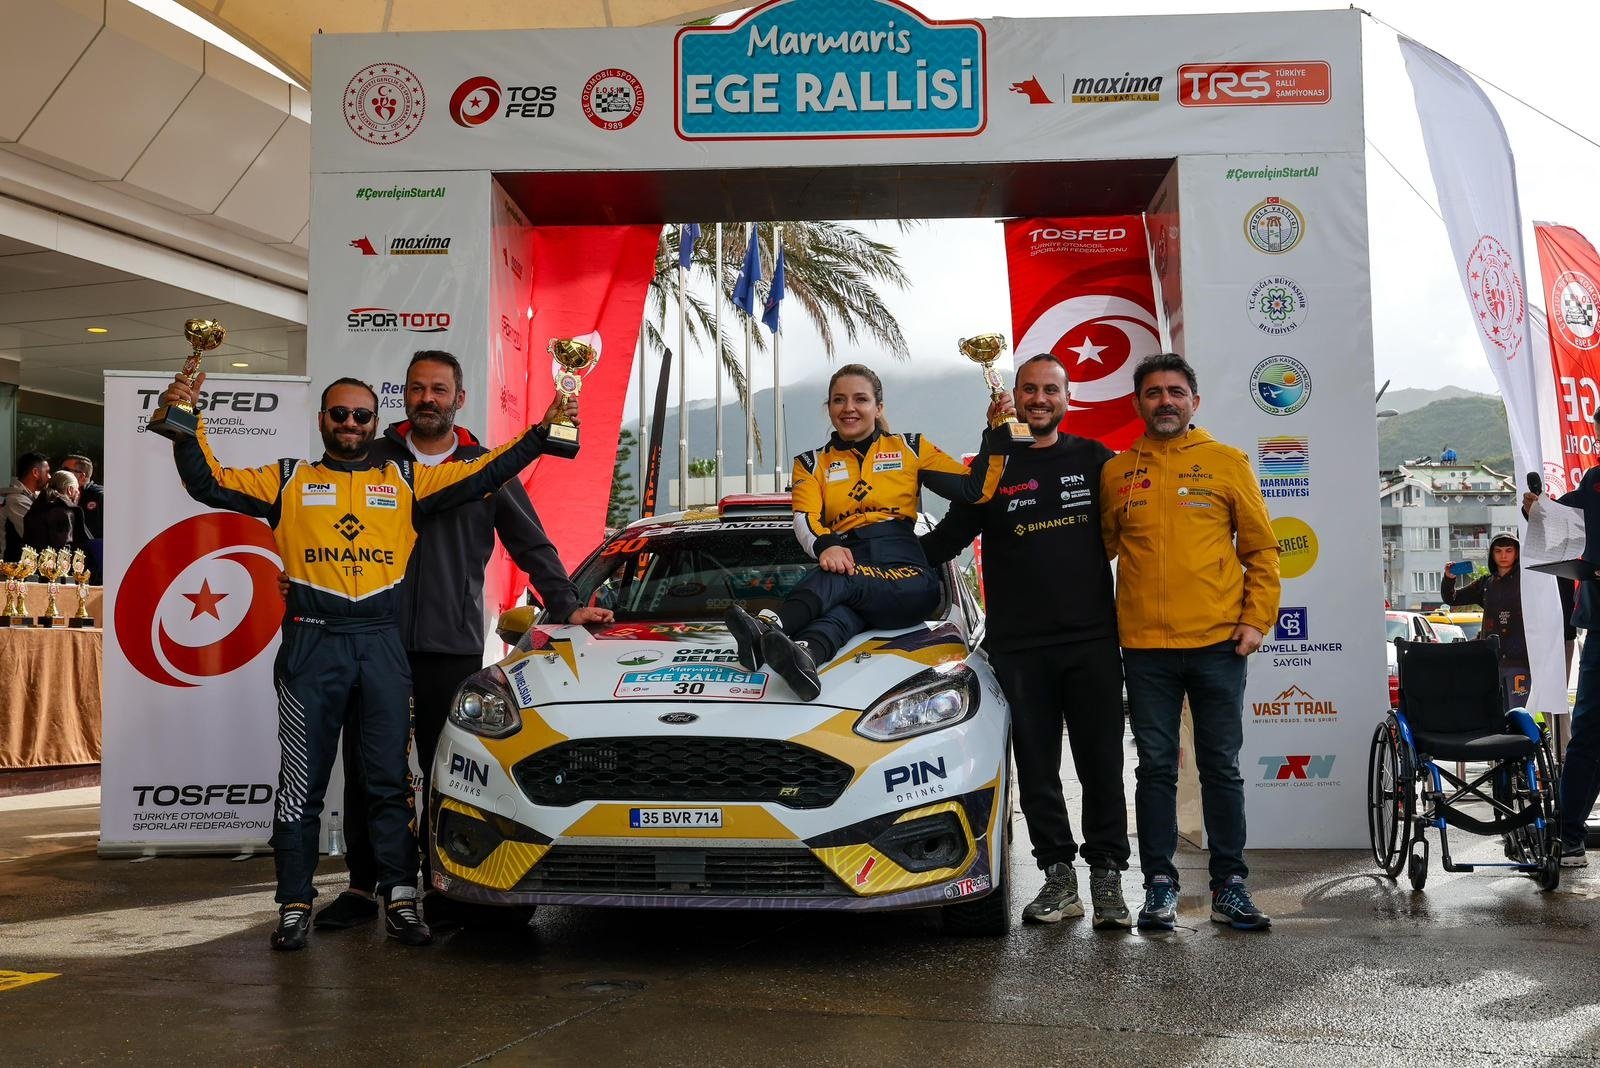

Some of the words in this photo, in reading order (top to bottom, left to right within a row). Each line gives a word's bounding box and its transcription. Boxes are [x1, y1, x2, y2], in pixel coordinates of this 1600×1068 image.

[747, 21, 911, 57] Marmaris
[1275, 68, 1306, 78] TÜRKİYE
[686, 73, 780, 114] EGE
[796, 58, 973, 112] RALLİSİ
[1072, 72, 1163, 94] maxima
[1183, 69, 1271, 101] TRS
[1275, 79, 1296, 88] RALLİ
[507, 86, 557, 102] TOS
[505, 103, 555, 118] FED
[390, 234, 451, 249] maxima
[1029, 228, 1127, 243] TOSFED
[137, 389, 279, 413] TSFED
[204, 426, 277, 436] EDERASYONU
[1060, 474, 1085, 485] PIN
[1260, 477, 1310, 488] MARMARİS
[367, 486, 396, 494] VESTEL
[725, 522, 794, 530] Moto
[1028, 516, 1076, 532] BINANCE
[1076, 514, 1088, 523] TR
[1278, 535, 1309, 553] ERECE
[304, 547, 394, 565] BINANCE
[342, 565, 364, 577] TR
[1256, 643, 1298, 653] LDWELL
[1300, 642, 1343, 652] BANKER
[672, 655, 739, 663] BELED
[1273, 658, 1312, 667] SAYGIN
[635, 673, 673, 682] EGE
[673, 682, 705, 695] 30
[1252, 702, 1290, 716] VAST
[1294, 701, 1338, 715] TRAIL
[667, 714, 691, 722] Ford
[450, 753, 489, 787] PIN
[884, 756, 948, 793] PIN
[132, 784, 273, 807] TOSFED
[449, 780, 481, 797] DRINKS
[896, 784, 945, 803] DRINKS
[134, 811, 179, 821] TÜRKİYE
[180, 809, 239, 820] OTOMOBİL
[642, 812, 659, 824] 35
[662, 811, 692, 824] BVR
[694, 811, 719, 824] 714
[132, 822, 187, 831] SPORLARI
[189, 821, 271, 830] FEDERASYONU
